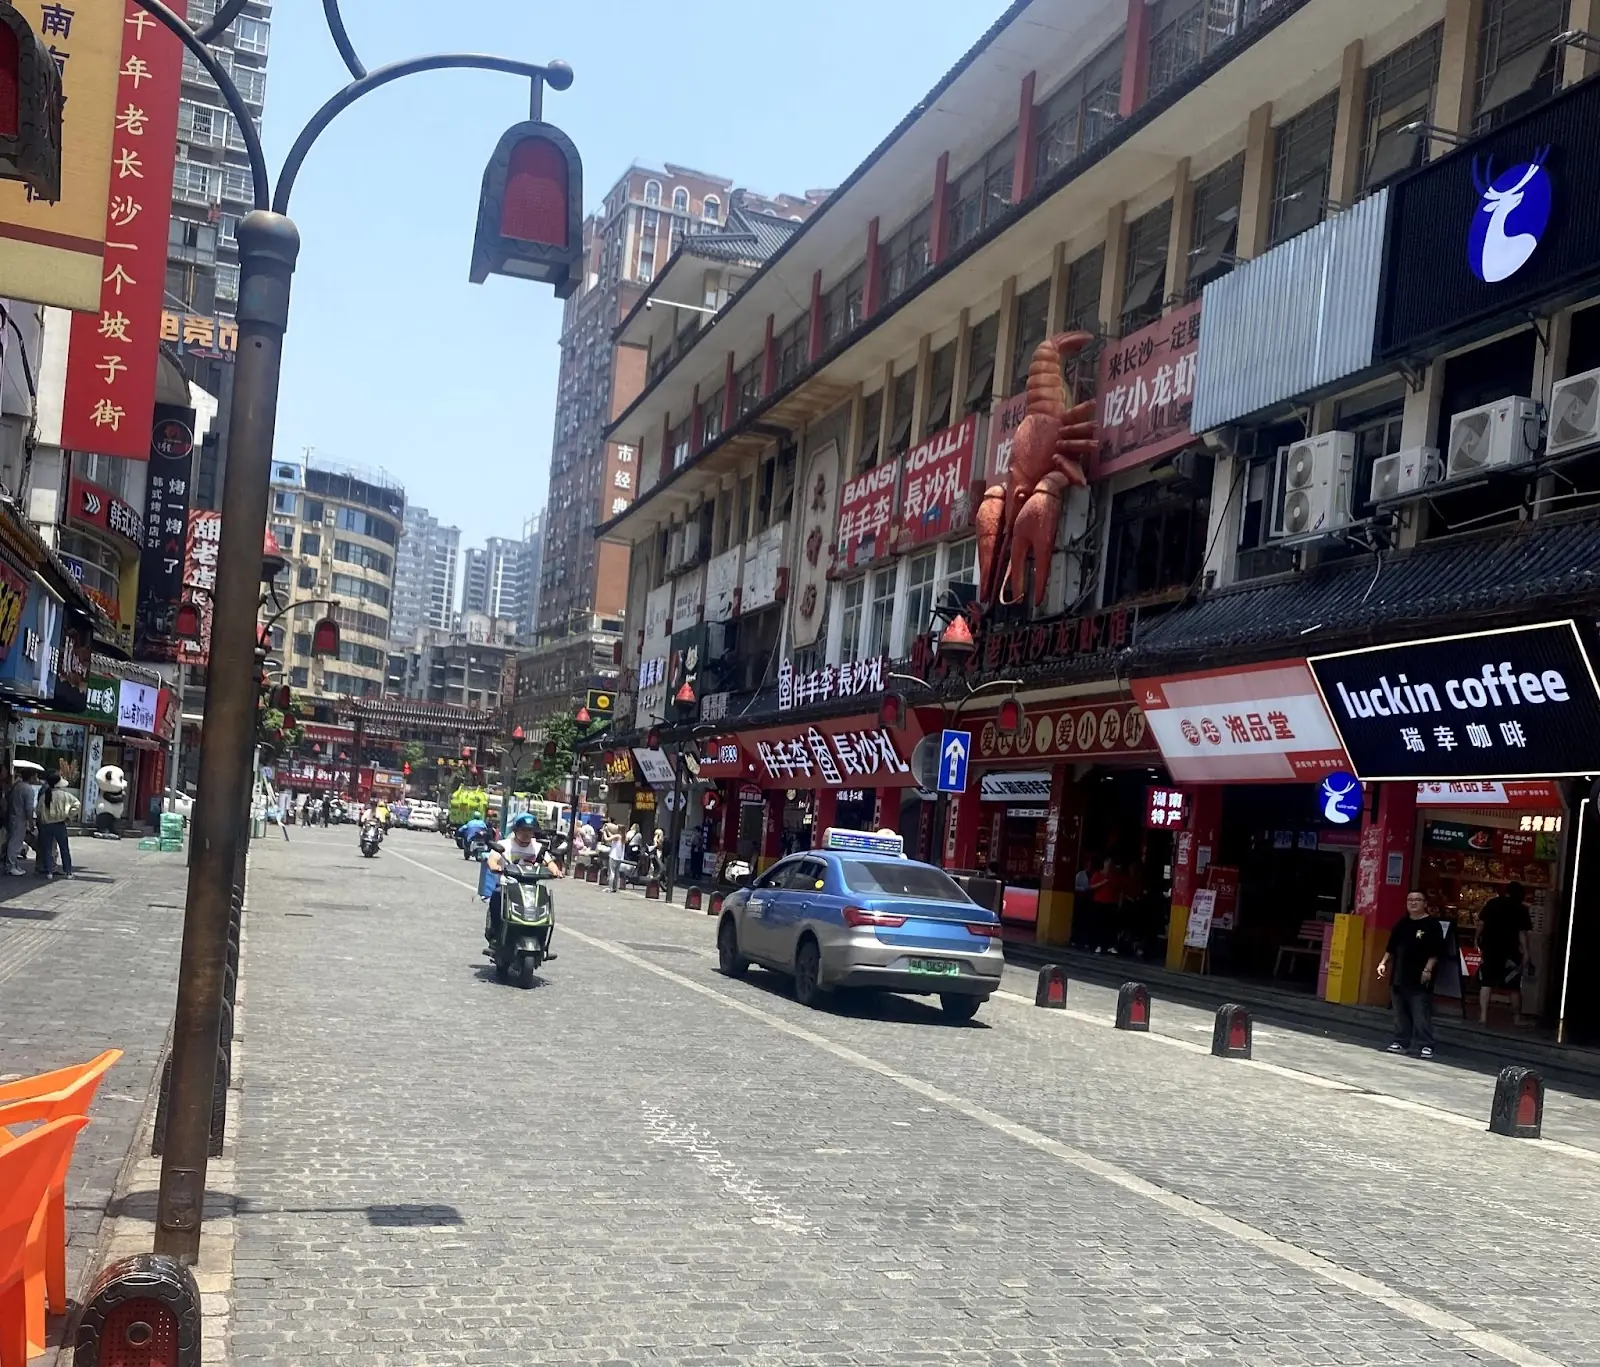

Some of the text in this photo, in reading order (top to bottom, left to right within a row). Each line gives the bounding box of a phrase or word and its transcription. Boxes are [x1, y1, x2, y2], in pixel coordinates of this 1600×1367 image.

[90, 9, 157, 432] 千年老长沙一个坡子街
[1107, 313, 1200, 381] 来长沙一定要
[1102, 351, 1197, 428] 吃小龙虾
[1000, 404, 1026, 433] 来长
[838, 494, 890, 552] 伴手李
[904, 456, 966, 522] 長沙礼
[793, 654, 885, 706] 伴手李 長沙礼
[1335, 661, 1570, 719] luckin coffee
[1222, 711, 1296, 744] 湘品堂
[1399, 720, 1528, 754] 瑞幸咖啡
[755, 728, 911, 781] 伴手李 長沙礼
[1150, 808, 1182, 826] 特产
[1152, 790, 1183, 808] 湖南
